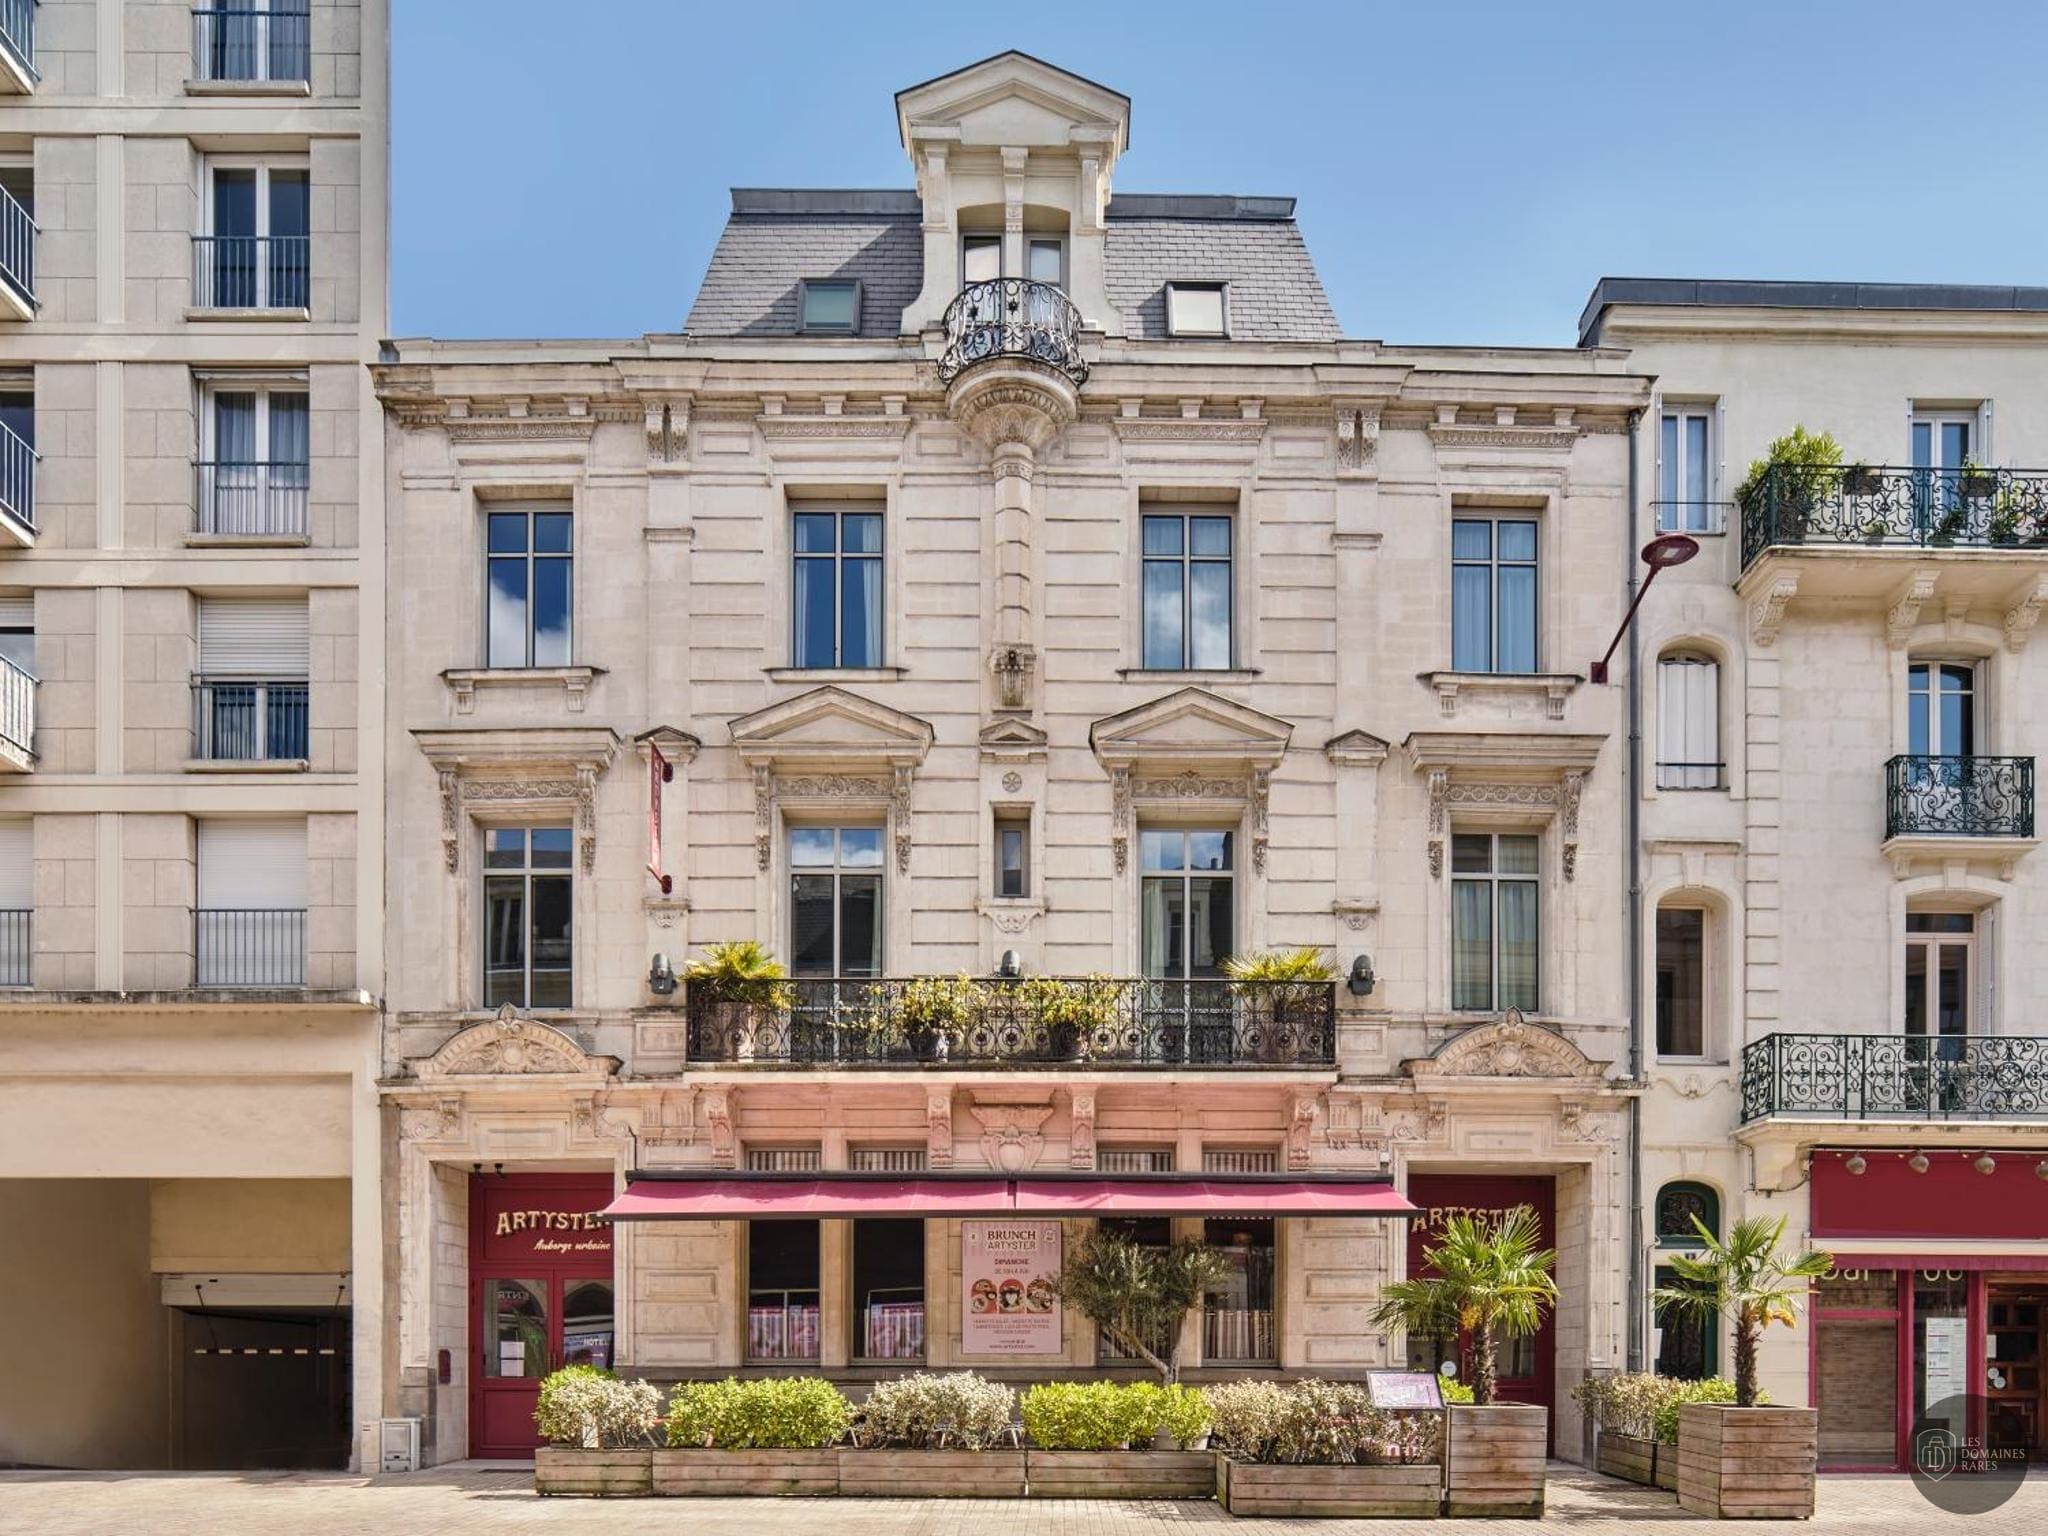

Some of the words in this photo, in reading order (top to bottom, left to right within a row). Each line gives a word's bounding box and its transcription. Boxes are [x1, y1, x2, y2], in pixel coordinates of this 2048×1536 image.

[987, 1230, 1036, 1240] BRUNCH
[534, 1239, 572, 1253] Auberge
[575, 1240, 611, 1250] urbaine
[987, 1241, 1036, 1249] ARTYSTER
